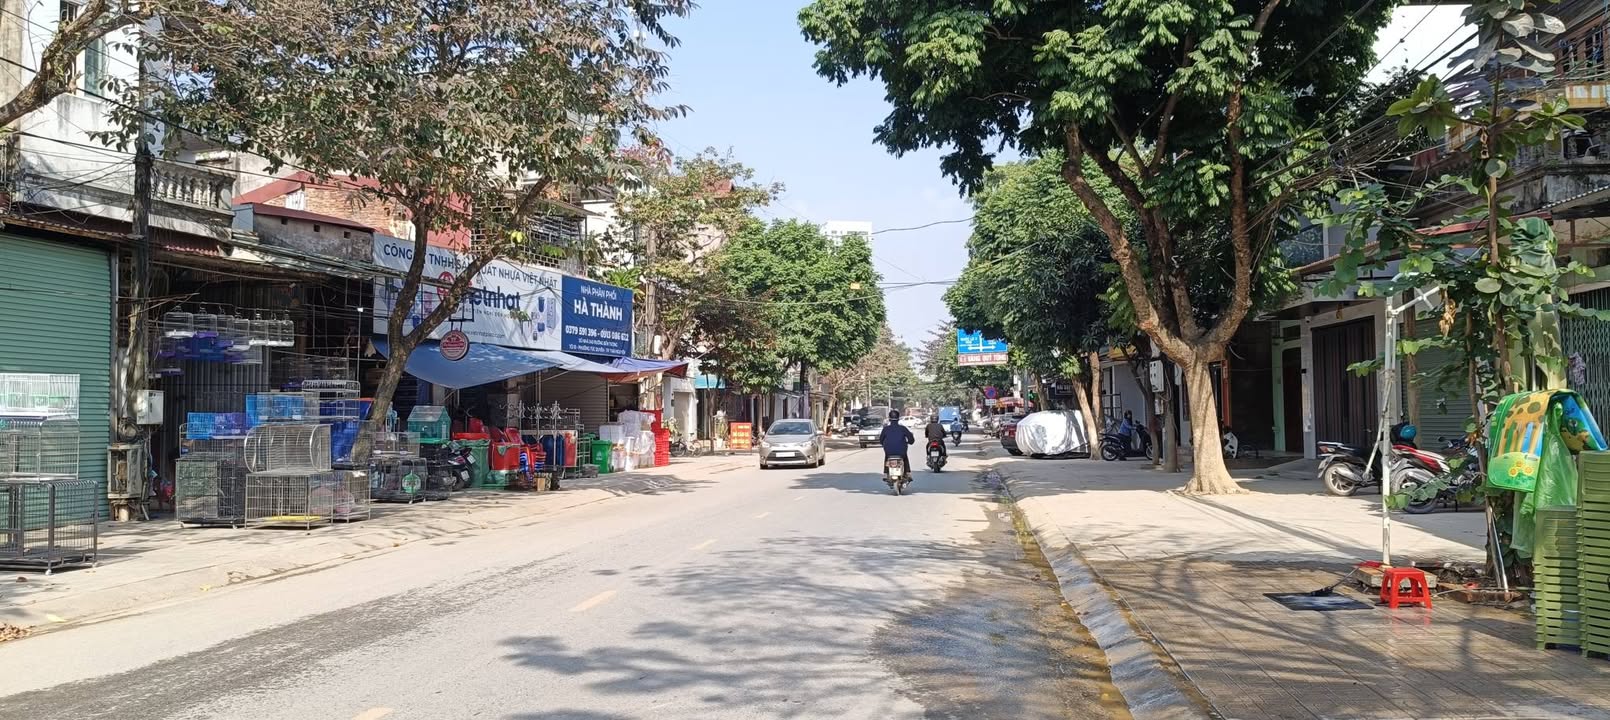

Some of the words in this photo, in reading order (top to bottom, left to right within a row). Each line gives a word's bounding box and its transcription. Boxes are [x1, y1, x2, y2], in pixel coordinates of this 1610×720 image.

[384, 243, 413, 260] CÔNG
[429, 253, 454, 269] TNHH
[499, 267, 520, 282] NHỰA
[581, 285, 591, 295] NHÀ
[574, 296, 588, 316] HÀ
[590, 301, 623, 321] THÀNH
